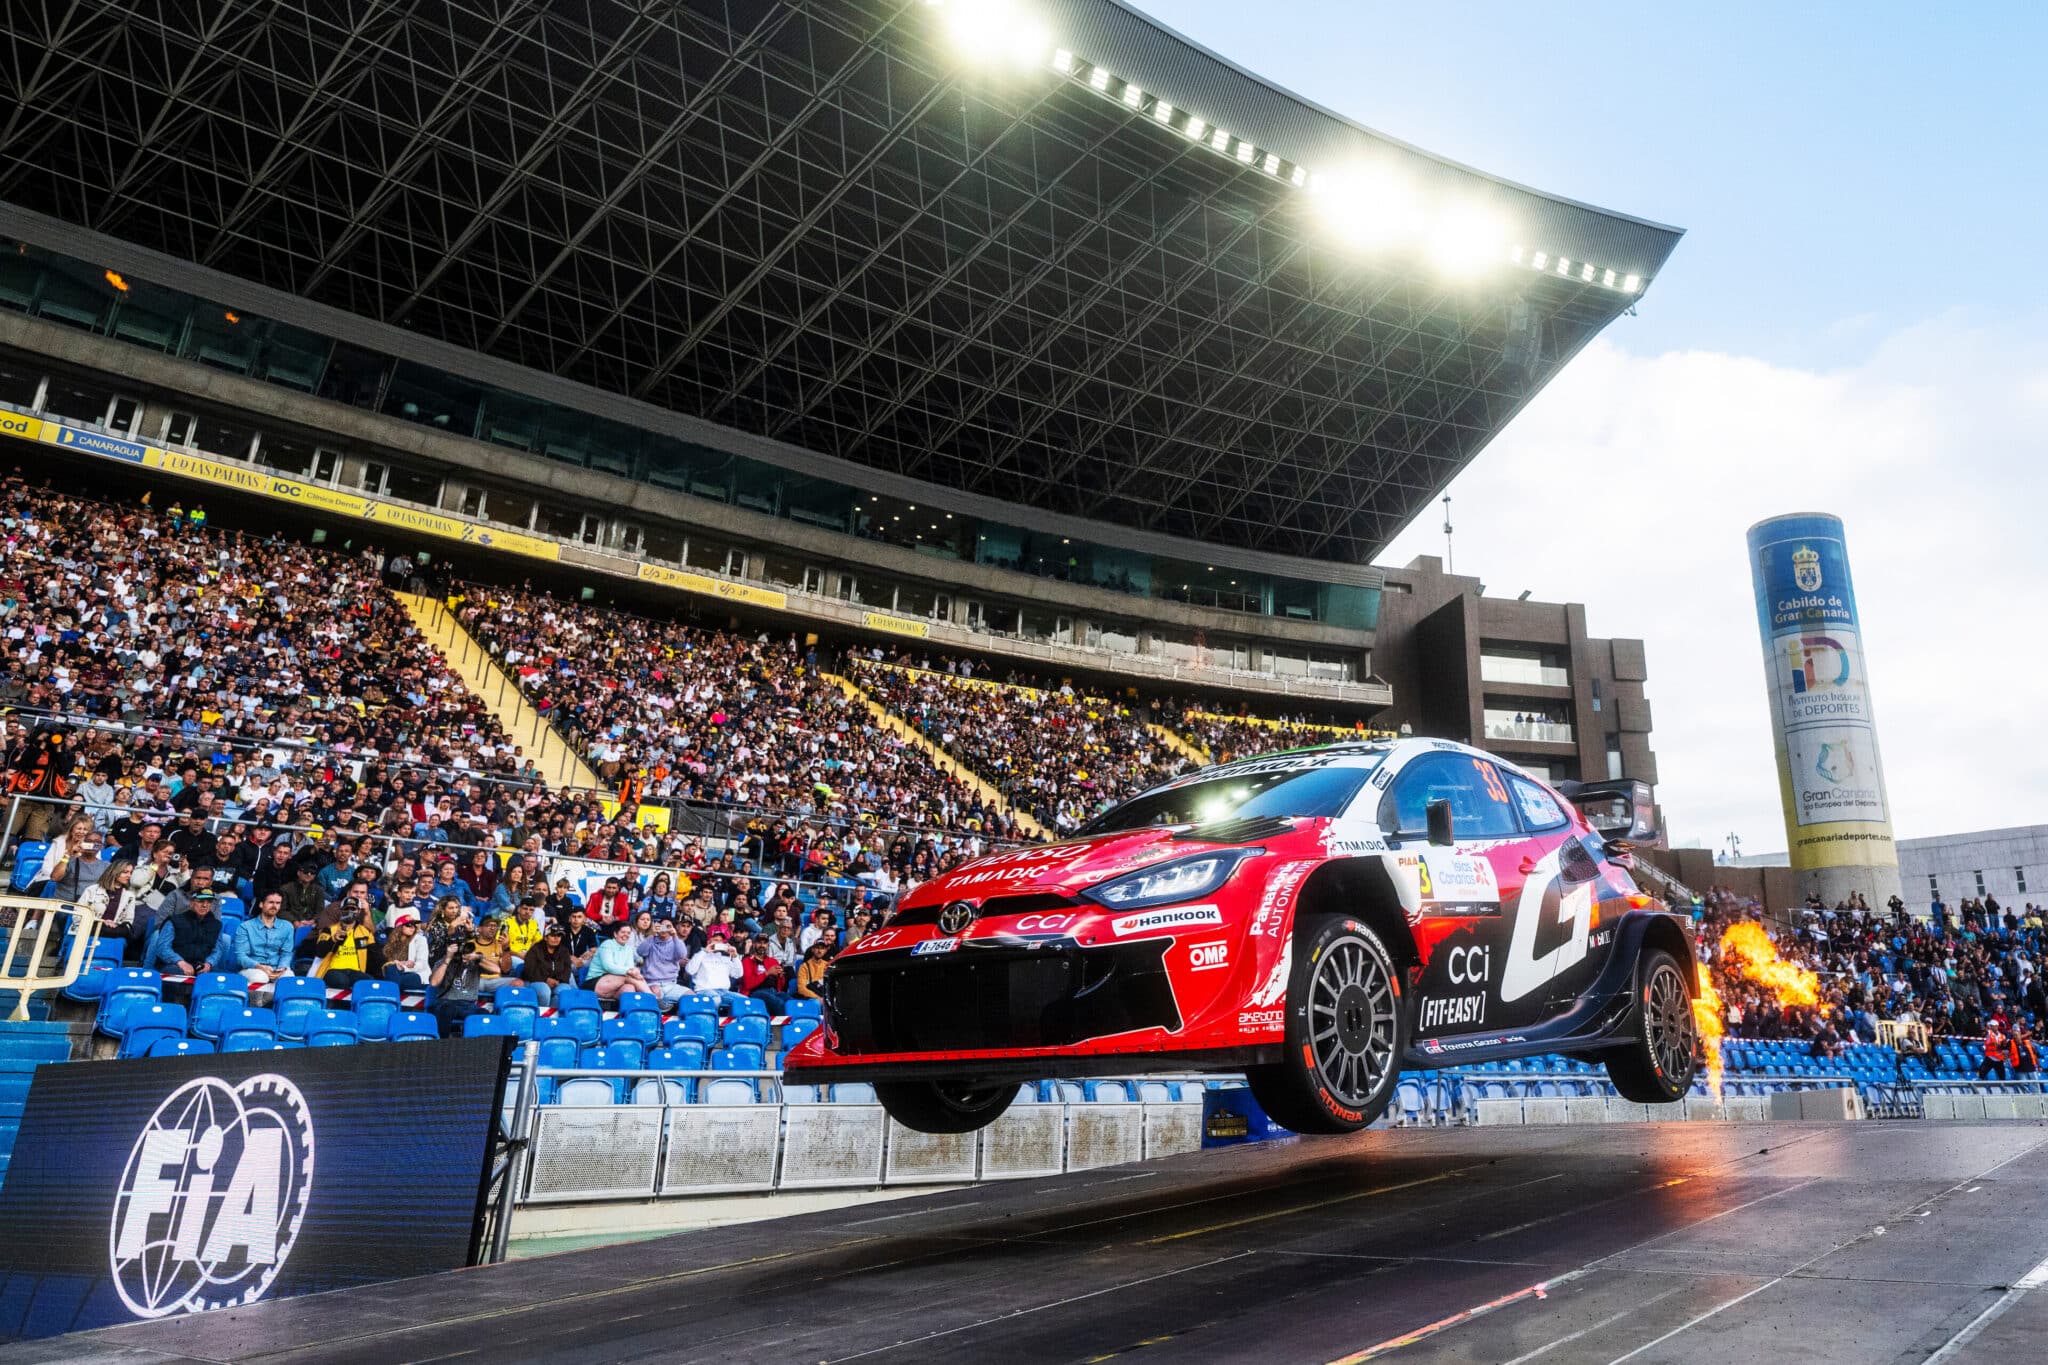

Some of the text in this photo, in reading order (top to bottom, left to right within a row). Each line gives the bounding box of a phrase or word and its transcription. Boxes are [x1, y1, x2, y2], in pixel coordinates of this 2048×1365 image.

[0, 419, 28, 433] od
[78, 435, 140, 459] CANARAGUA
[213, 466, 259, 487] PALMAS
[417, 515, 453, 532] PALMAS
[1778, 595, 1842, 611] Cabildo de
[1775, 607, 1850, 623] Gran Canaria
[1805, 703, 1860, 716] DEPORTES
[1472, 758, 1509, 804] 33
[1336, 840, 1385, 851] TAMADIC
[1398, 856, 1418, 867] PIAA
[945, 864, 1050, 889] TAMADIC
[1440, 871, 1476, 886] Canarias
[1267, 859, 1316, 938] AUTOMOTIVE
[1189, 945, 1228, 966] OMP
